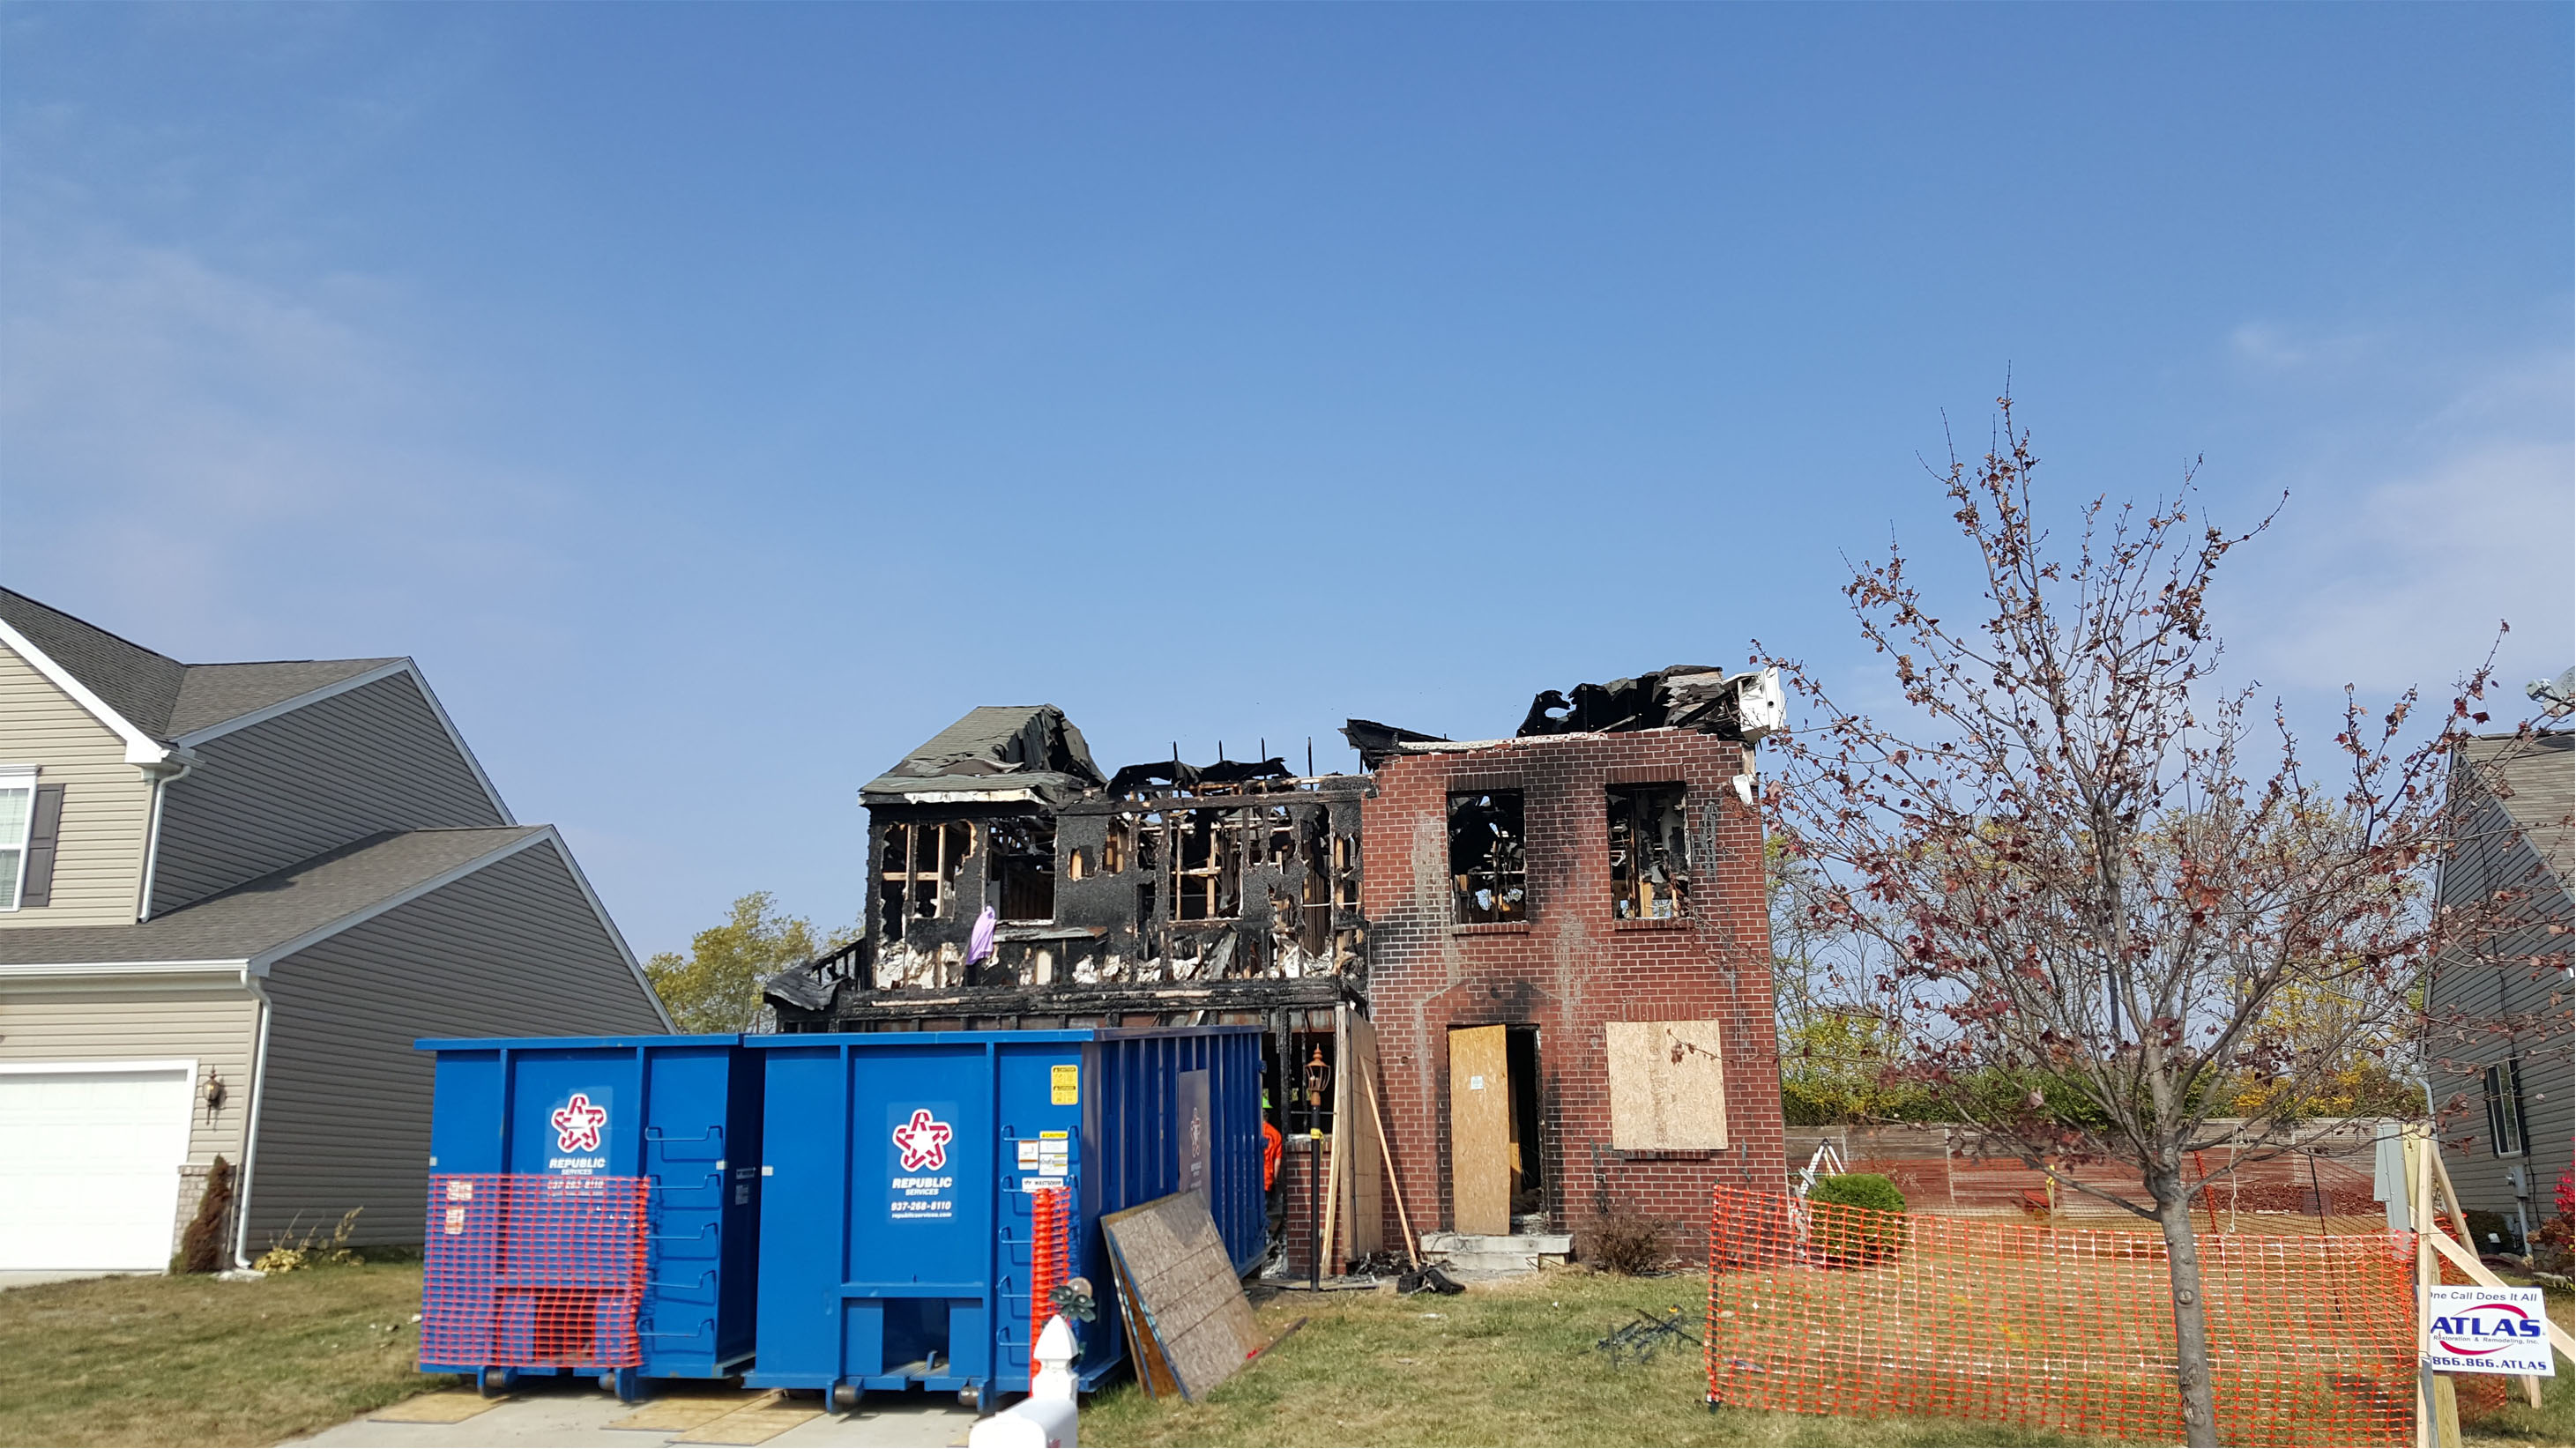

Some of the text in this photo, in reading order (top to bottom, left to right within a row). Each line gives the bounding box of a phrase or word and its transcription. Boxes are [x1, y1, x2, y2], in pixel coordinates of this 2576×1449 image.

[549, 1157, 607, 1169] REPUBLIC
[892, 1177, 952, 1188] REPUBLIC
[2451, 1291, 2473, 1300] Call
[2476, 1292, 2506, 1301] Does
[2520, 1293, 2537, 1302] All
[2430, 1317, 2541, 1337] ATLAS
